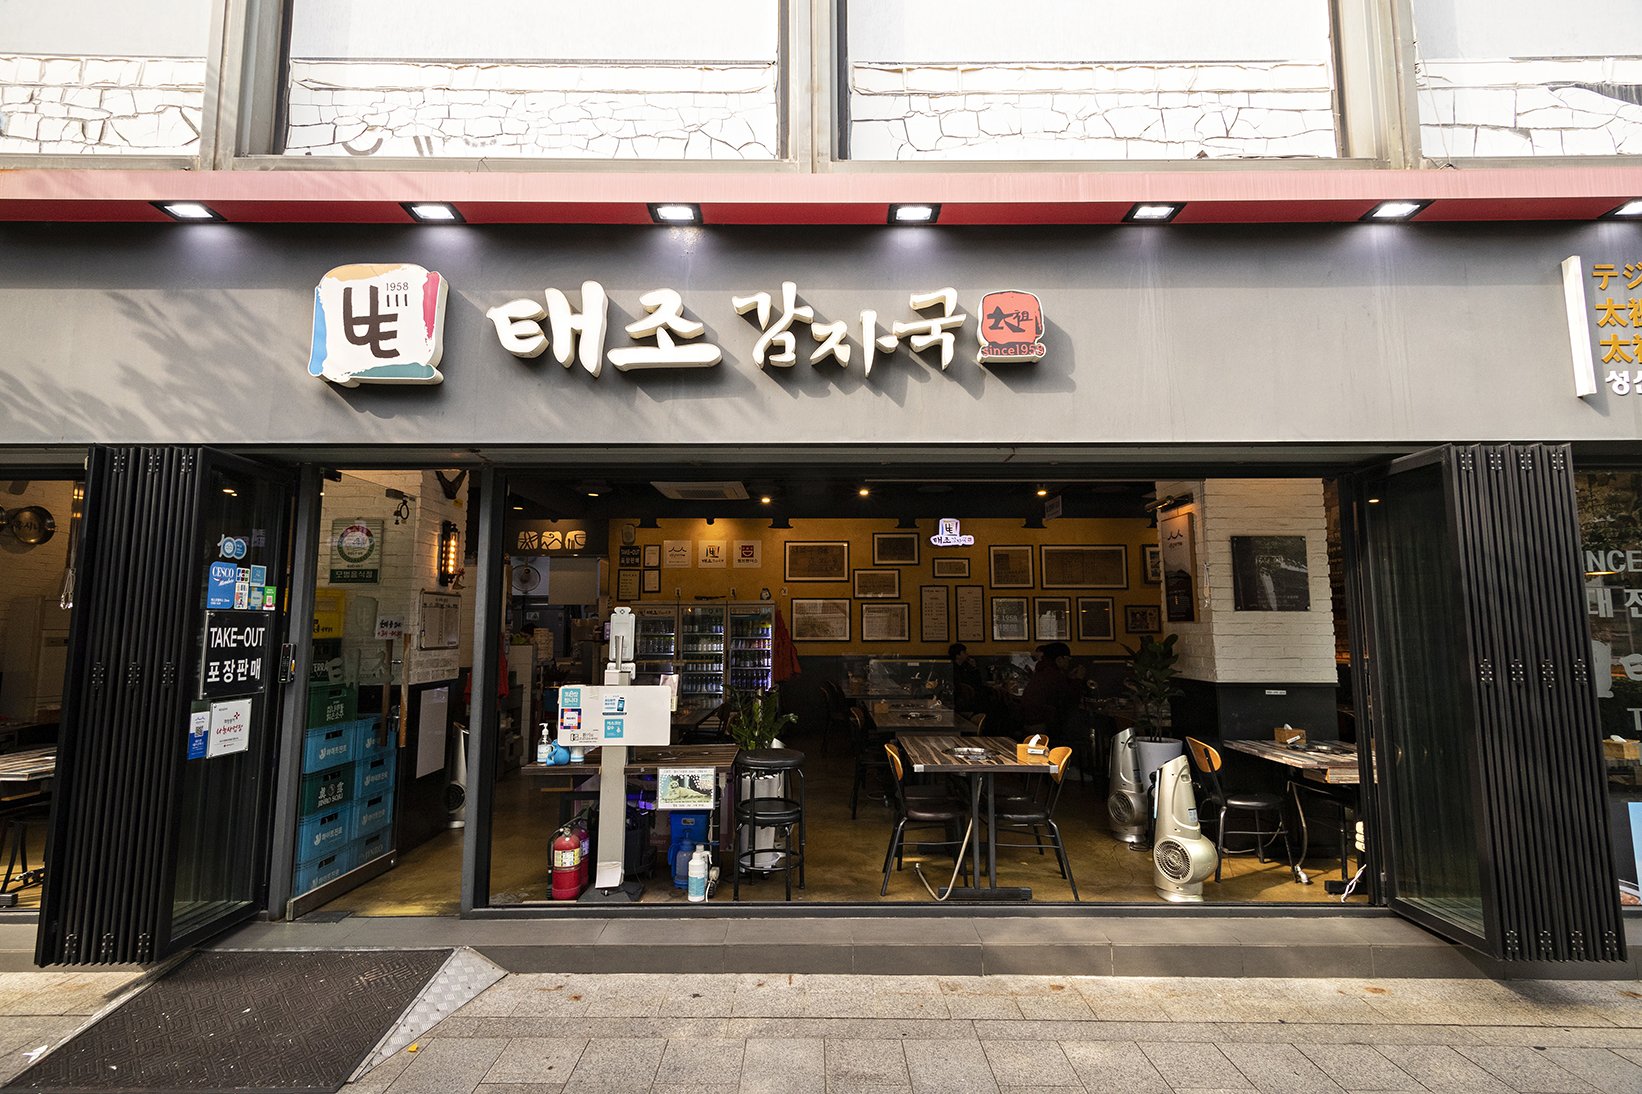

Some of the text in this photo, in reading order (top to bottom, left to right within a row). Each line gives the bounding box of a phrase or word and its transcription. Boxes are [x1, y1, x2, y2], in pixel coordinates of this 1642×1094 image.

[385, 281, 409, 292] 1958
[212, 566, 235, 578] CESCO
[336, 570, 372, 579] 모범음식점
[210, 627, 265, 648] TAKE-OUT
[207, 658, 262, 683] 포장판매
